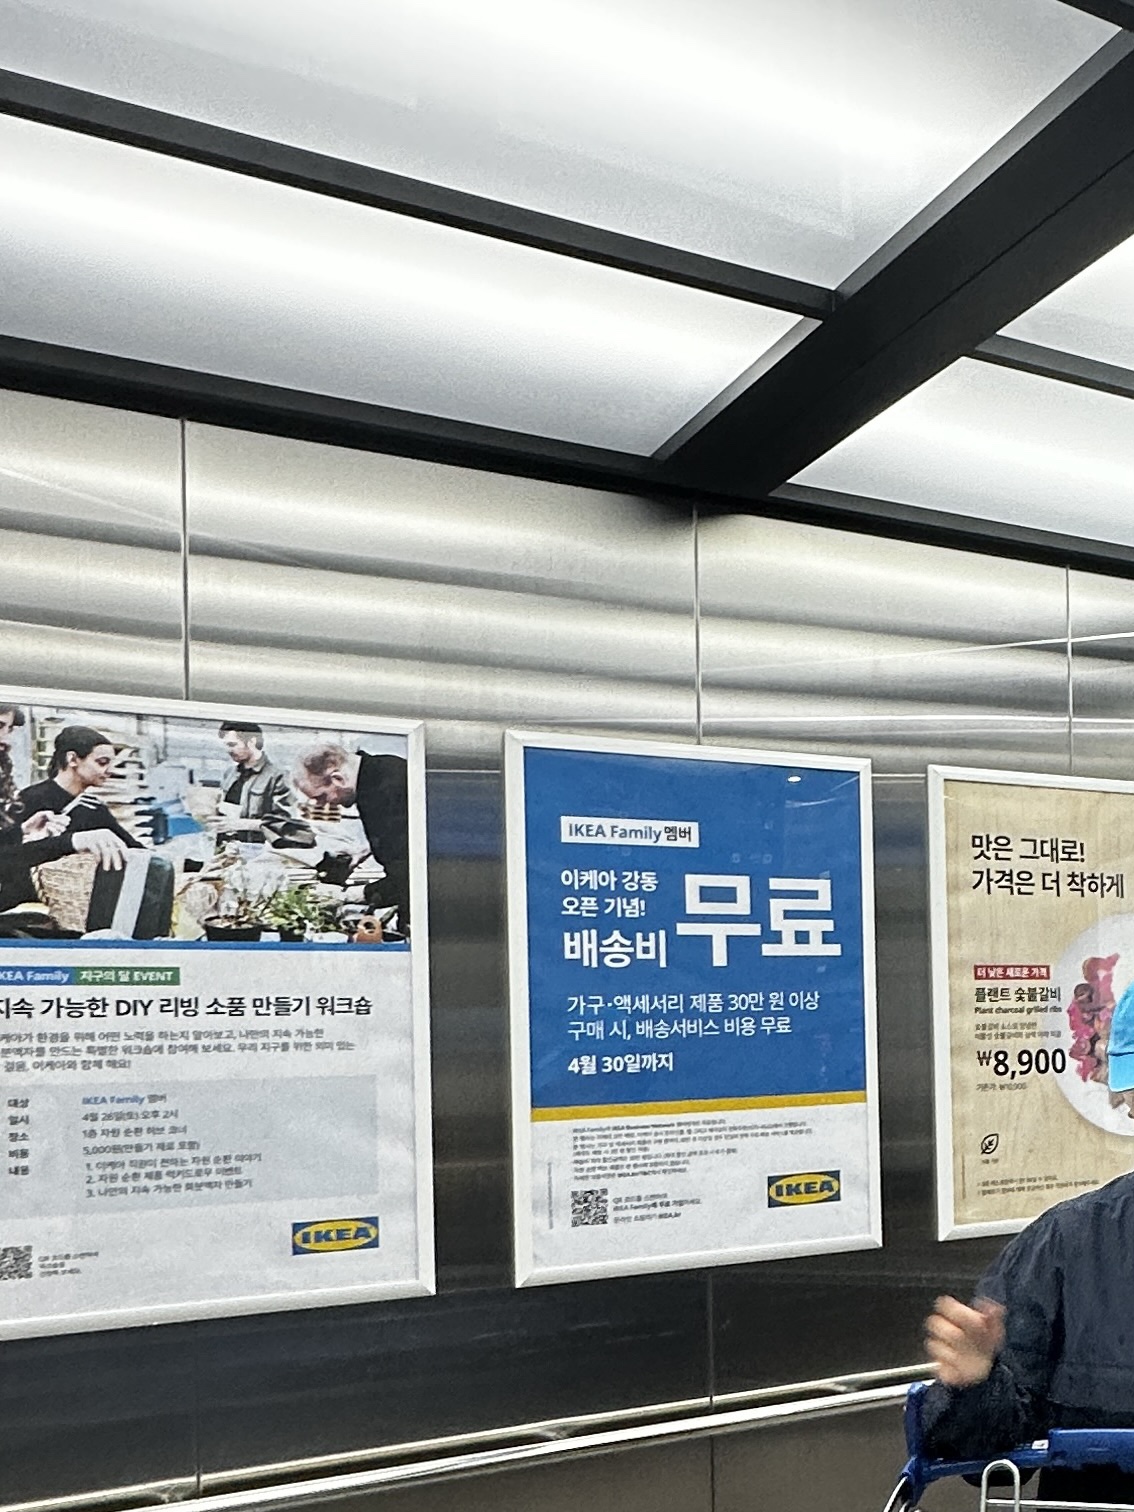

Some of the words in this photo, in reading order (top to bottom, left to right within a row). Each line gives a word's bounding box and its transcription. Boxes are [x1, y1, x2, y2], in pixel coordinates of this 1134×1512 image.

[569, 823, 606, 838] IKEA
[610, 825, 662, 844] Family
[664, 825, 692, 842] 멤버
[971, 834, 1013, 861] 맛은
[1020, 838, 1085, 863] 그대로!
[561, 869, 618, 891] 이케아
[622, 870, 659, 892] 강동
[972, 868, 1035, 896] 가격은
[1042, 871, 1061, 897] 더
[1067, 871, 1125, 898] 착하게
[561, 896, 599, 918] 오픈
[604, 897, 646, 918] 기념!
[676, 874, 842, 968] 무료
[563, 928, 667, 969] 배송비
[0, 971, 24, 982] KEA
[27, 970, 70, 984] Family
[79, 970, 115, 982] 지구의
[118, 970, 130, 982] 달
[133, 971, 174, 982] EVENT
[976, 967, 987, 978] 더
[988, 967, 1005, 978] 낮은
[1031, 967, 1048, 978] 가격
[689, 993, 724, 1014] 제품
[728, 992, 765, 1012] 30만
[769, 992, 786, 1012] 원
[789, 990, 820, 1011] 이상
[975, 987, 1012, 1003] 플랜트
[1015, 986, 1061, 1003] 숯불갈비
[40, 996, 109, 1019] 가능한
[115, 999, 154, 1017] DIY
[159, 996, 200, 1018] 리빙
[205, 997, 247, 1017] 소품
[252, 996, 311, 1017] 만들기
[315, 996, 374, 1016] 워크숍
[0, 1031, 33, 1043] 케아가
[567, 1020, 605, 1042] 구매
[609, 1019, 632, 1041] 시,
[635, 1017, 720, 1039] 배송서비스
[724, 1016, 757, 1037] 비용
[760, 1016, 793, 1036] 무료
[567, 1055, 598, 1076] 4월
[601, 1052, 674, 1074] 30일까지
[775, 1180, 835, 1198] IKEA
[302, 1225, 374, 1245] IKEA
